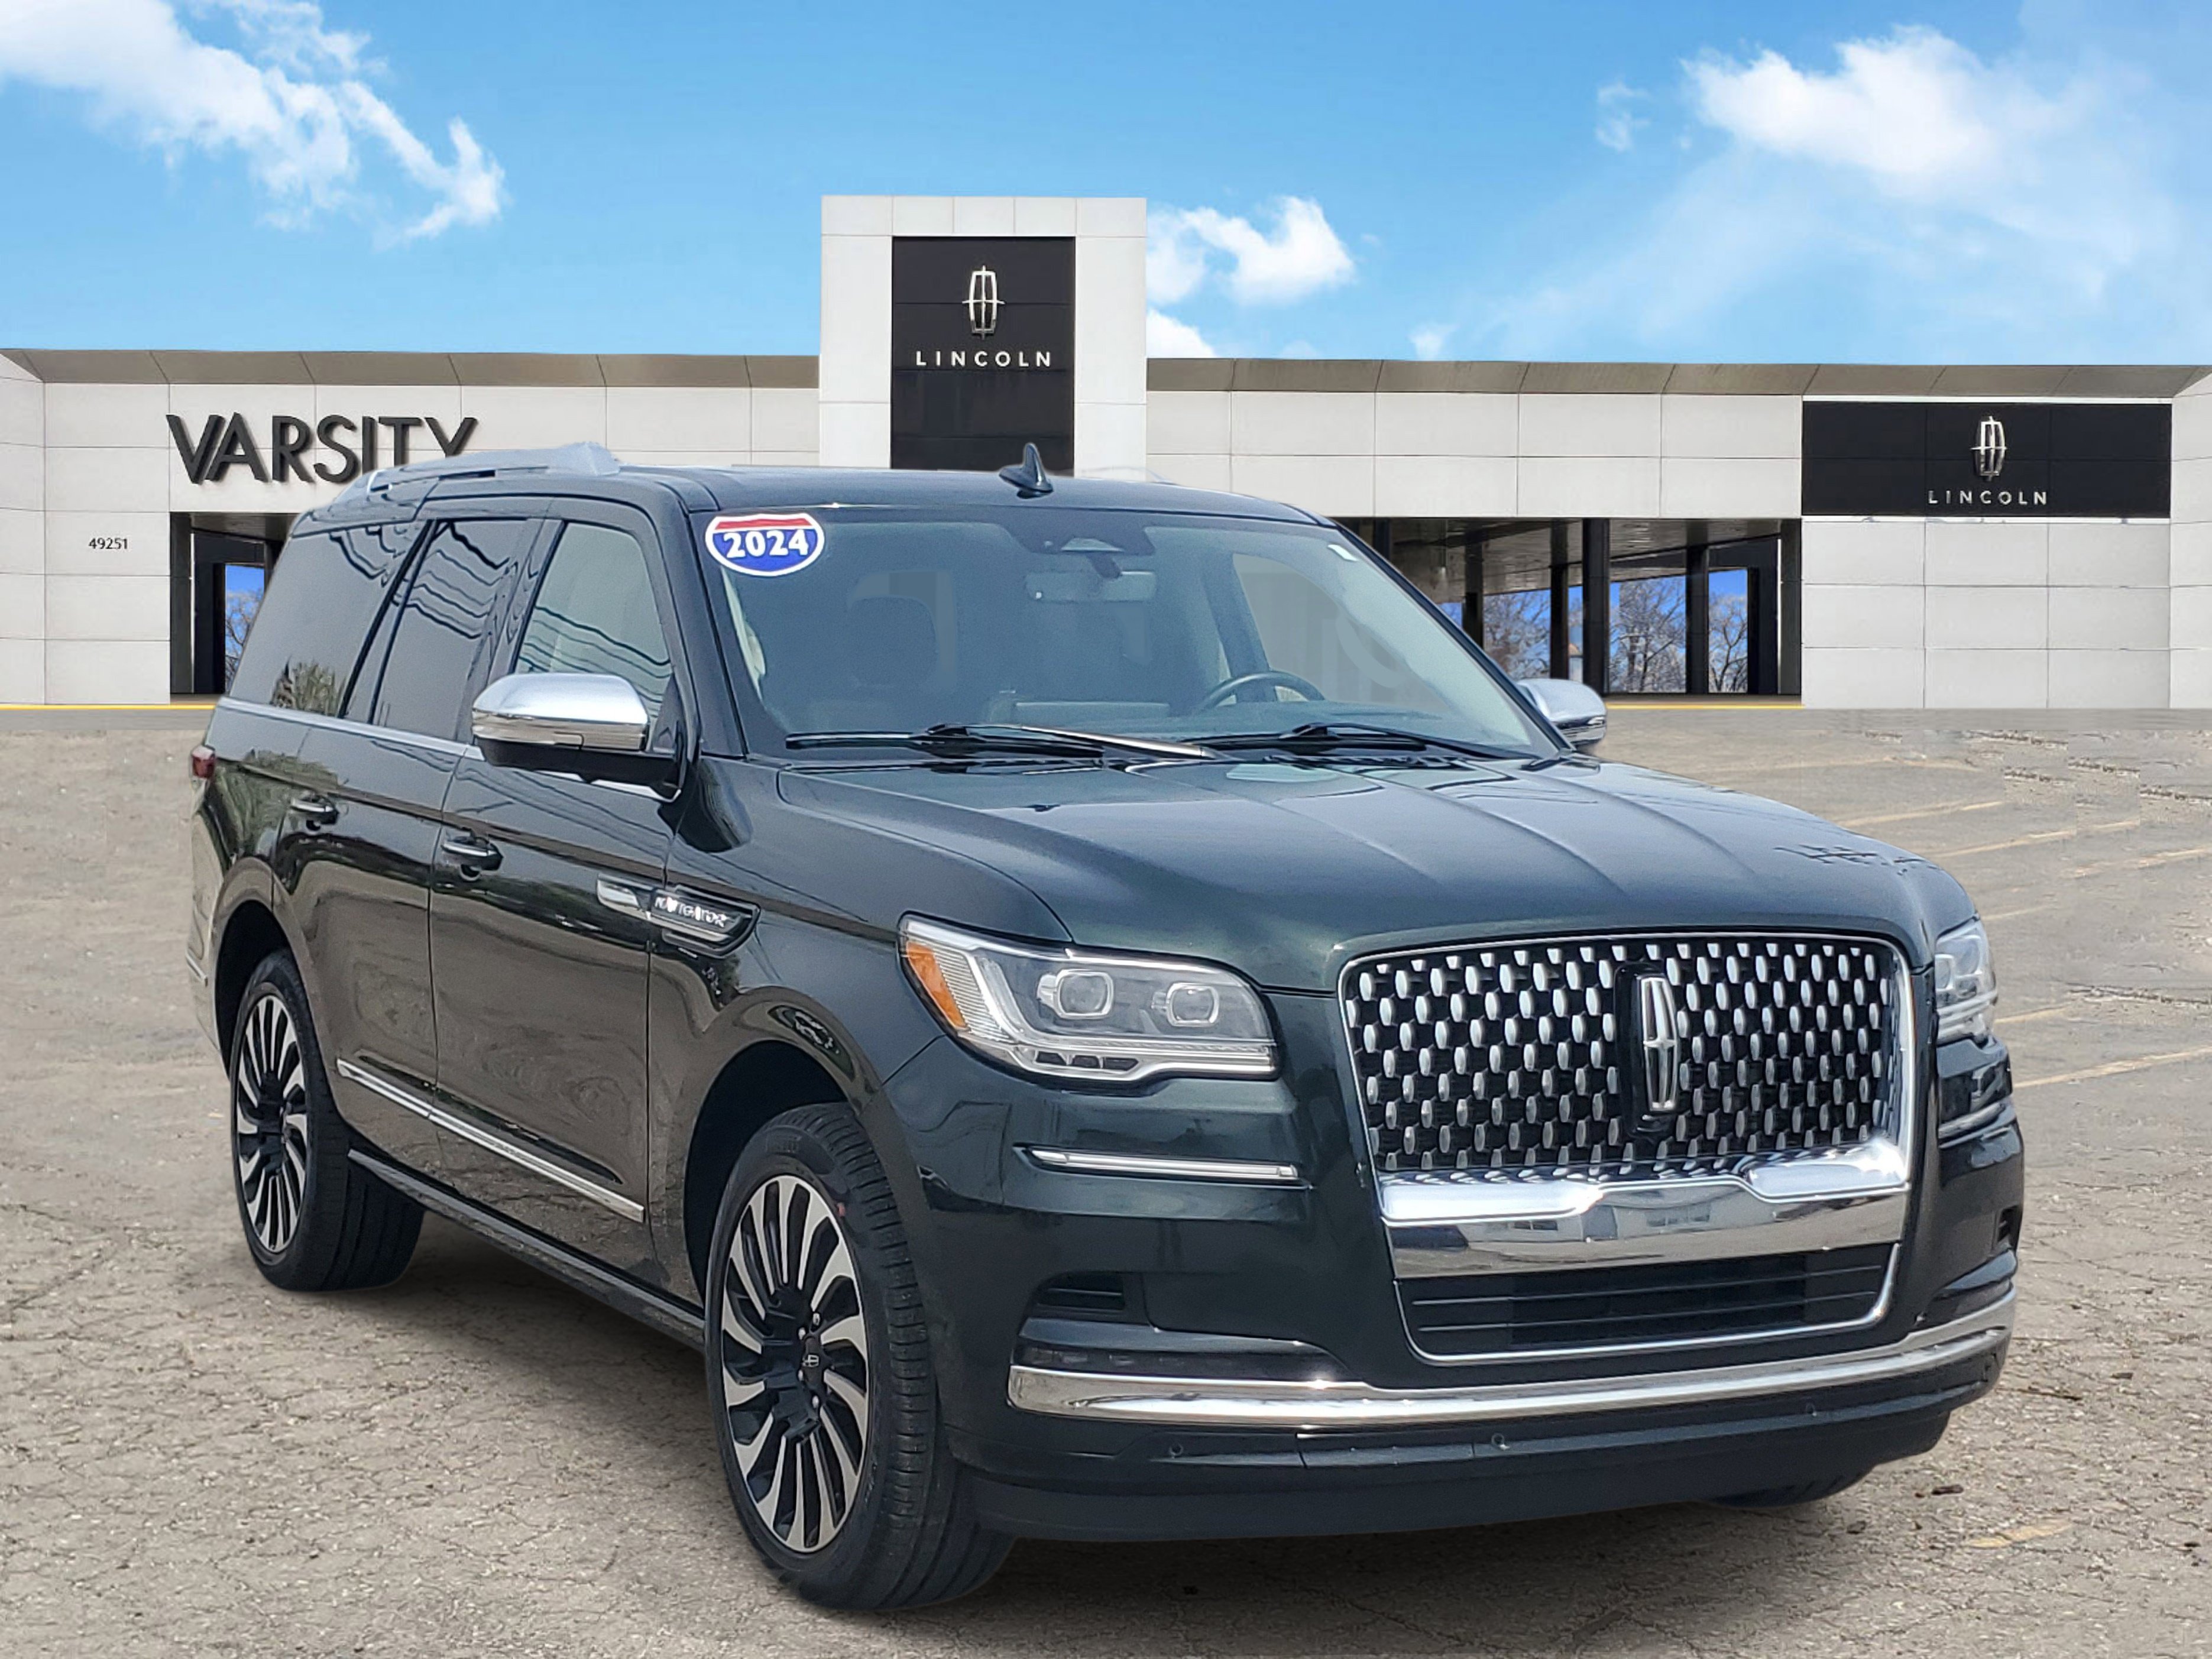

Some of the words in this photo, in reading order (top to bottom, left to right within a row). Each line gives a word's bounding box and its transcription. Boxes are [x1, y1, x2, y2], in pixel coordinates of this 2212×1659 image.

[916, 351, 1050, 367] LINCOLN
[166, 411, 478, 484] VARSITY
[1928, 490, 2047, 506] LINCOLN
[89, 538, 128, 549] 49251
[724, 530, 808, 558] 2024
